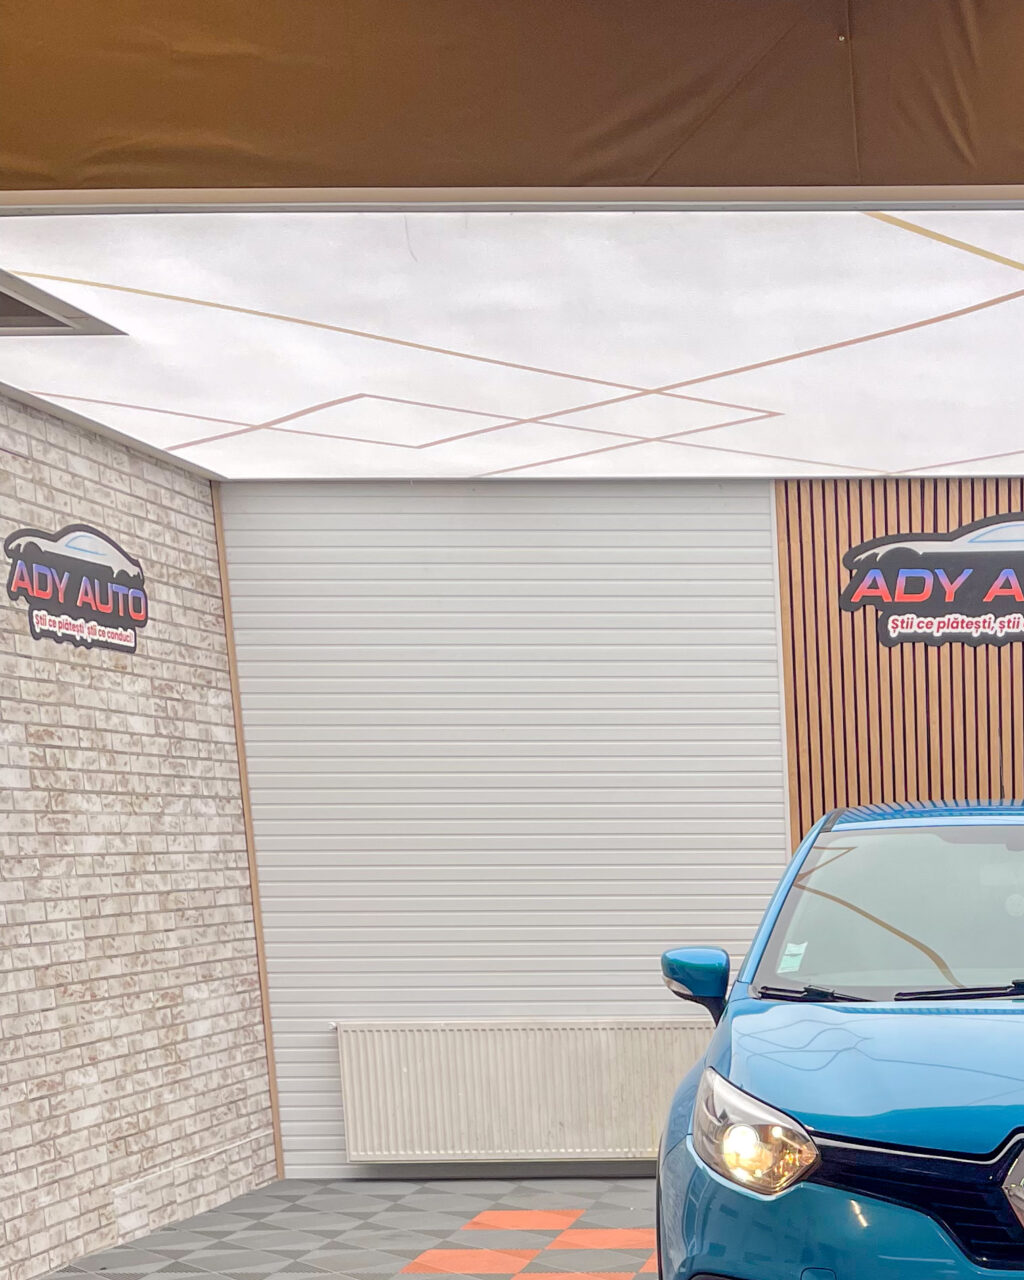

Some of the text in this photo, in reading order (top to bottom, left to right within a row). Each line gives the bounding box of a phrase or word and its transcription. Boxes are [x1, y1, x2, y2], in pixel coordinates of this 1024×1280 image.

[11, 560, 146, 621] ADY AUTO
[851, 568, 973, 602] ADY
[891, 617, 914, 634] Știi
[917, 620, 934, 630] ce
[998, 617, 1021, 634] știi
